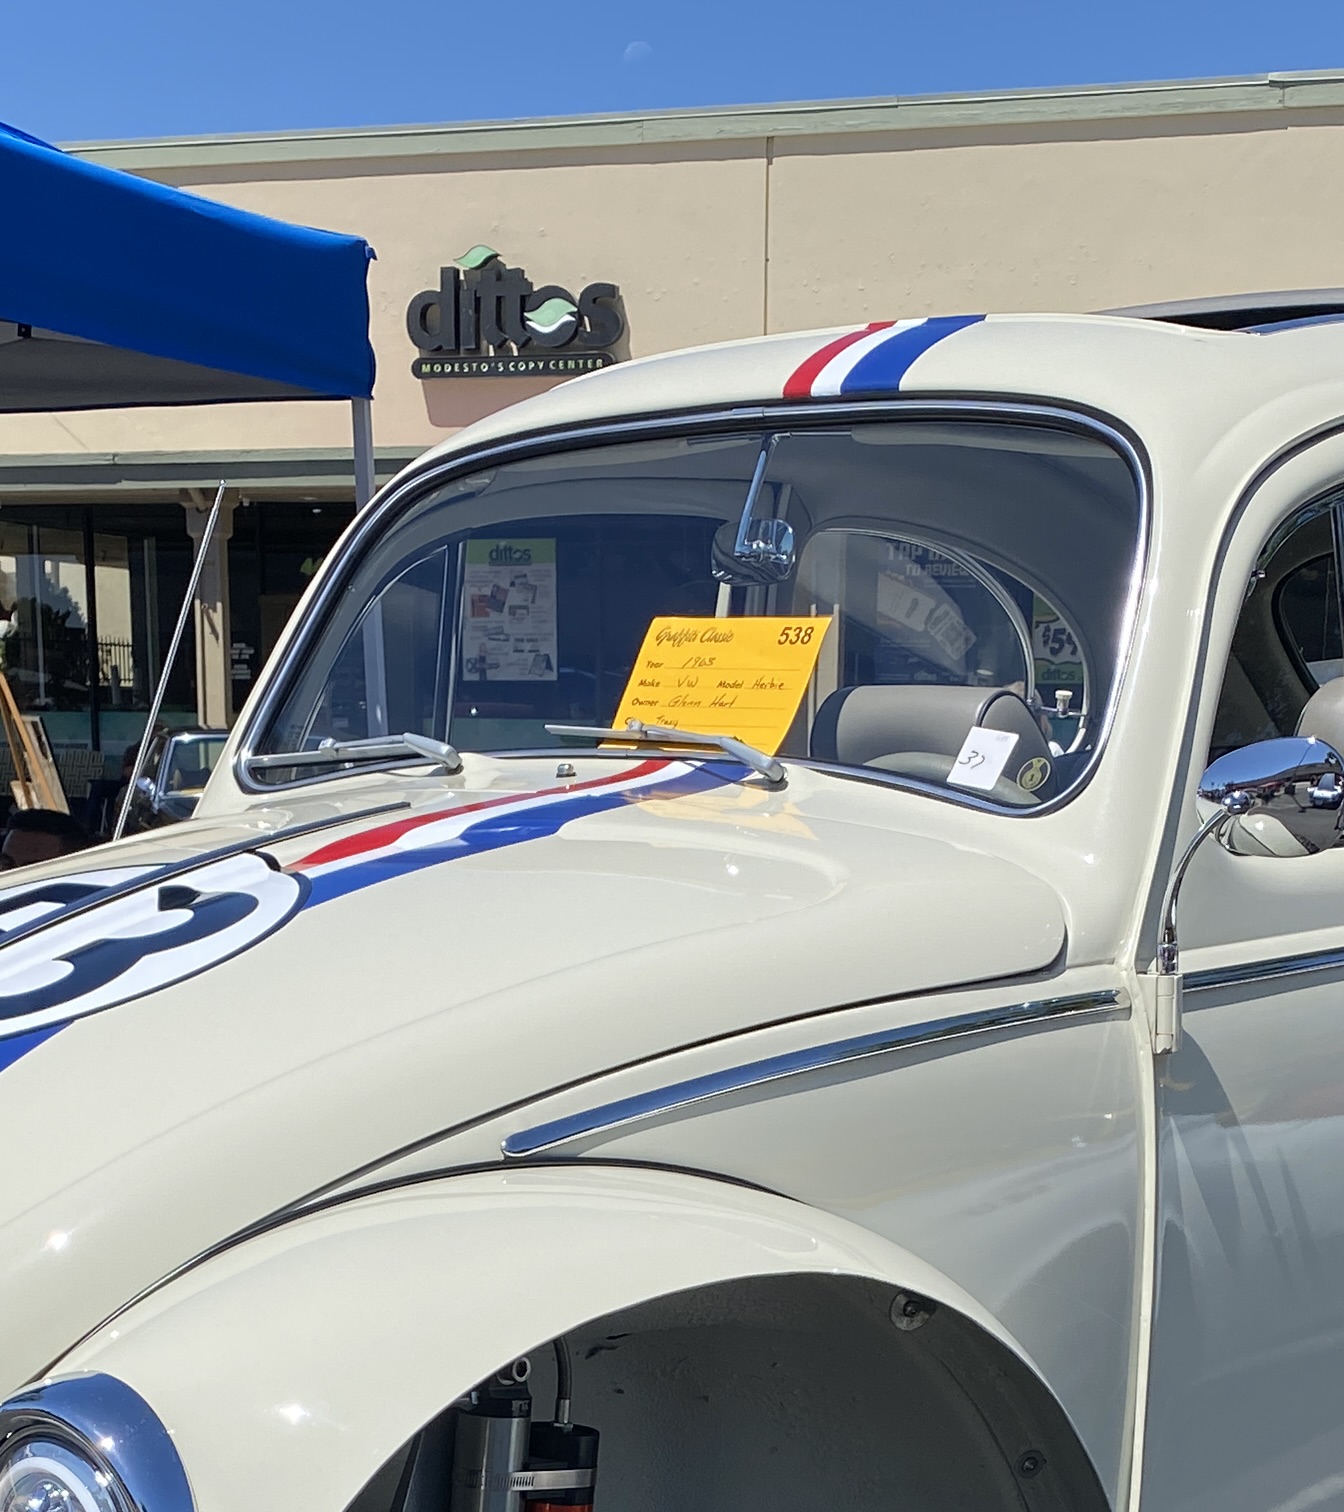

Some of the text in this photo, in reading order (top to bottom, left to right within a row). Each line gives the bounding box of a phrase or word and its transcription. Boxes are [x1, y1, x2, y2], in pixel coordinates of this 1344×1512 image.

[406, 246, 625, 351] dittos
[421, 357, 604, 373] MODESTO'S COPY CENTER
[699, 626, 734, 645] Classic
[777, 625, 815, 646] 538
[646, 659, 664, 669] Year
[637, 679, 661, 688] Make
[676, 674, 699, 689] VW
[716, 679, 745, 689] Model
[631, 698, 660, 707] Owner
